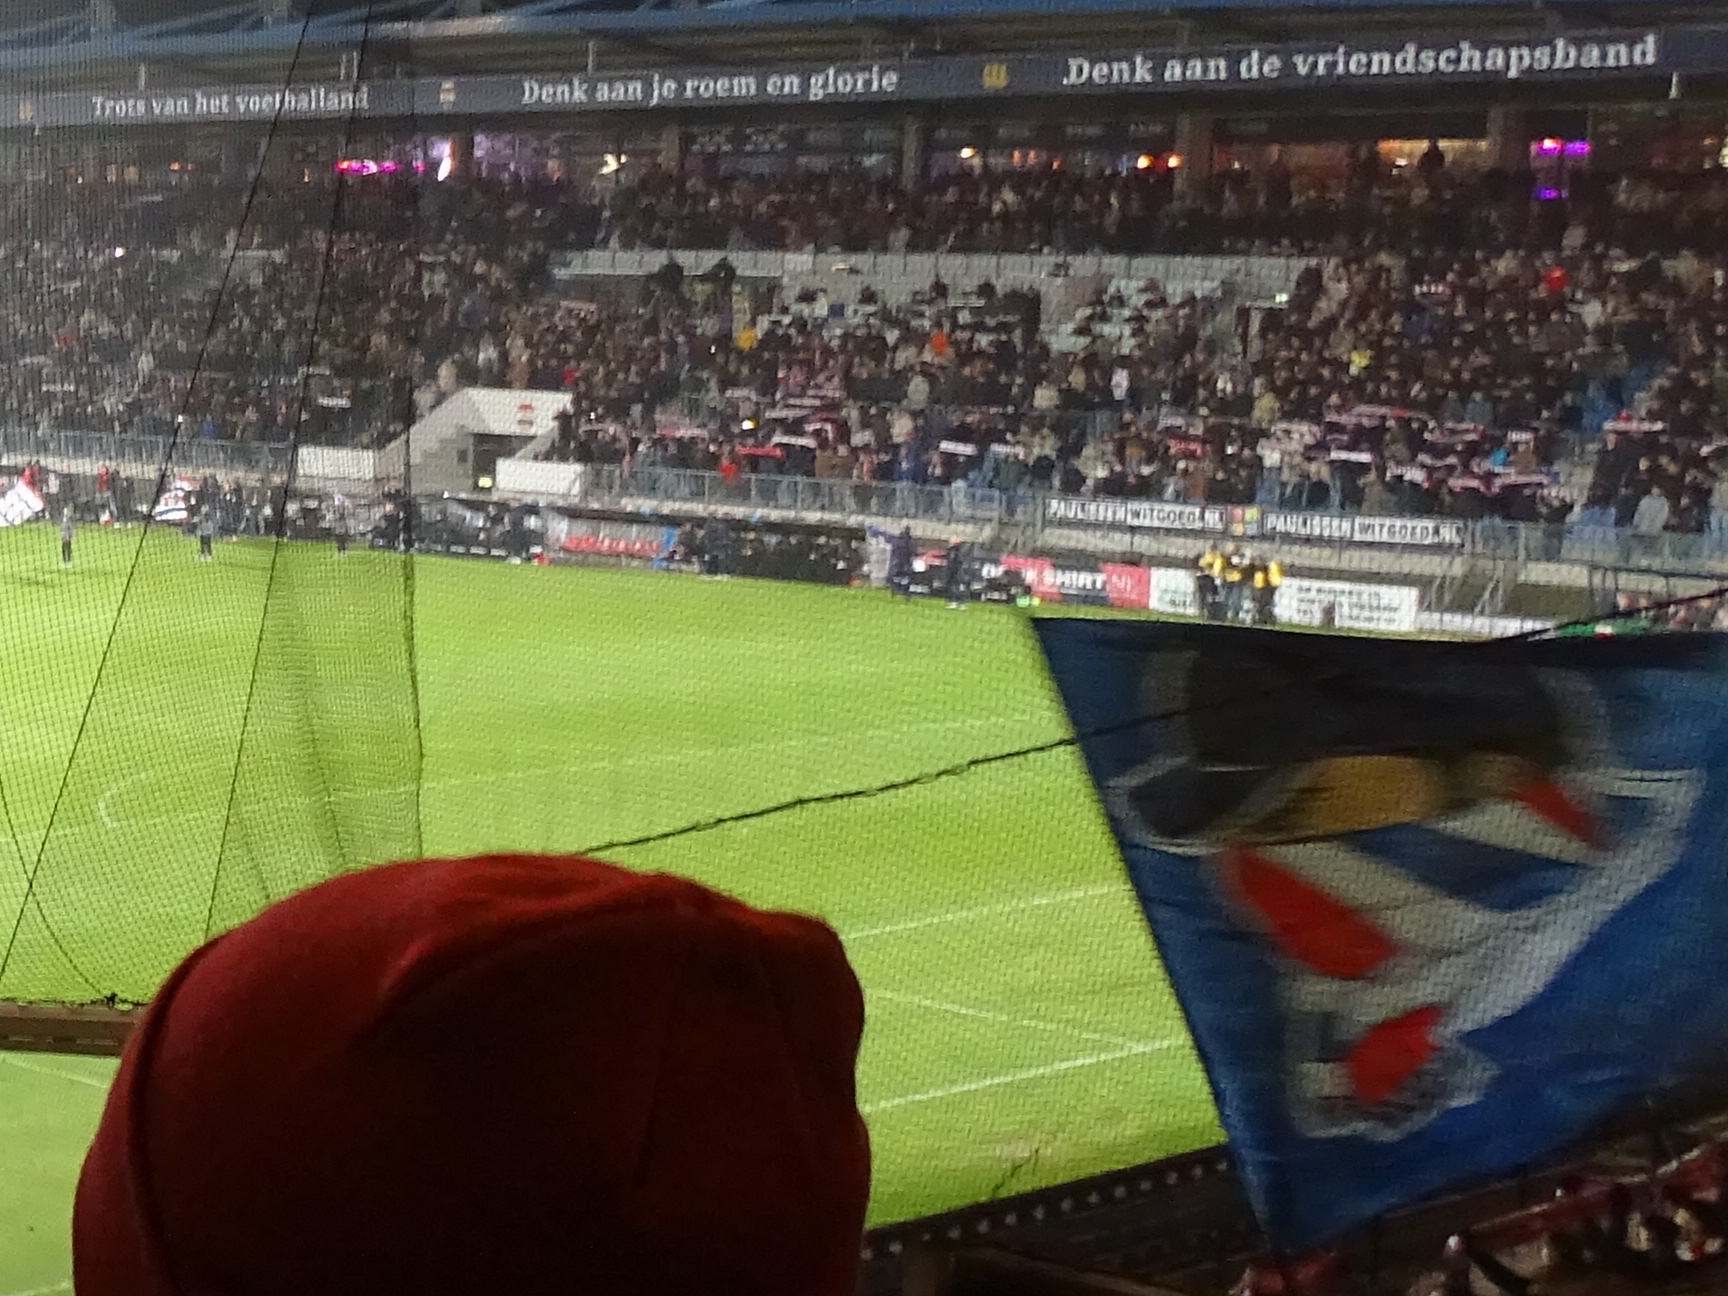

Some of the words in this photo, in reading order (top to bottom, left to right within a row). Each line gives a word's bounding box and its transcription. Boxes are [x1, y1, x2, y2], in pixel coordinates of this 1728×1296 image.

[1066, 54, 1153, 85] Denk
[1164, 56, 1230, 82] aan
[1239, 50, 1282, 79] de
[1293, 34, 1658, 79] vriendschapsband
[91, 94, 146, 118] Trots
[151, 96, 190, 116] van
[194, 89, 230, 115] het
[235, 85, 370, 113] voetballand
[520, 77, 589, 105] Denk
[595, 79, 644, 102] aan
[649, 72, 676, 107] je
[684, 75, 757, 99] roem
[766, 73, 800, 96] en
[809, 64, 898, 101] glorie
